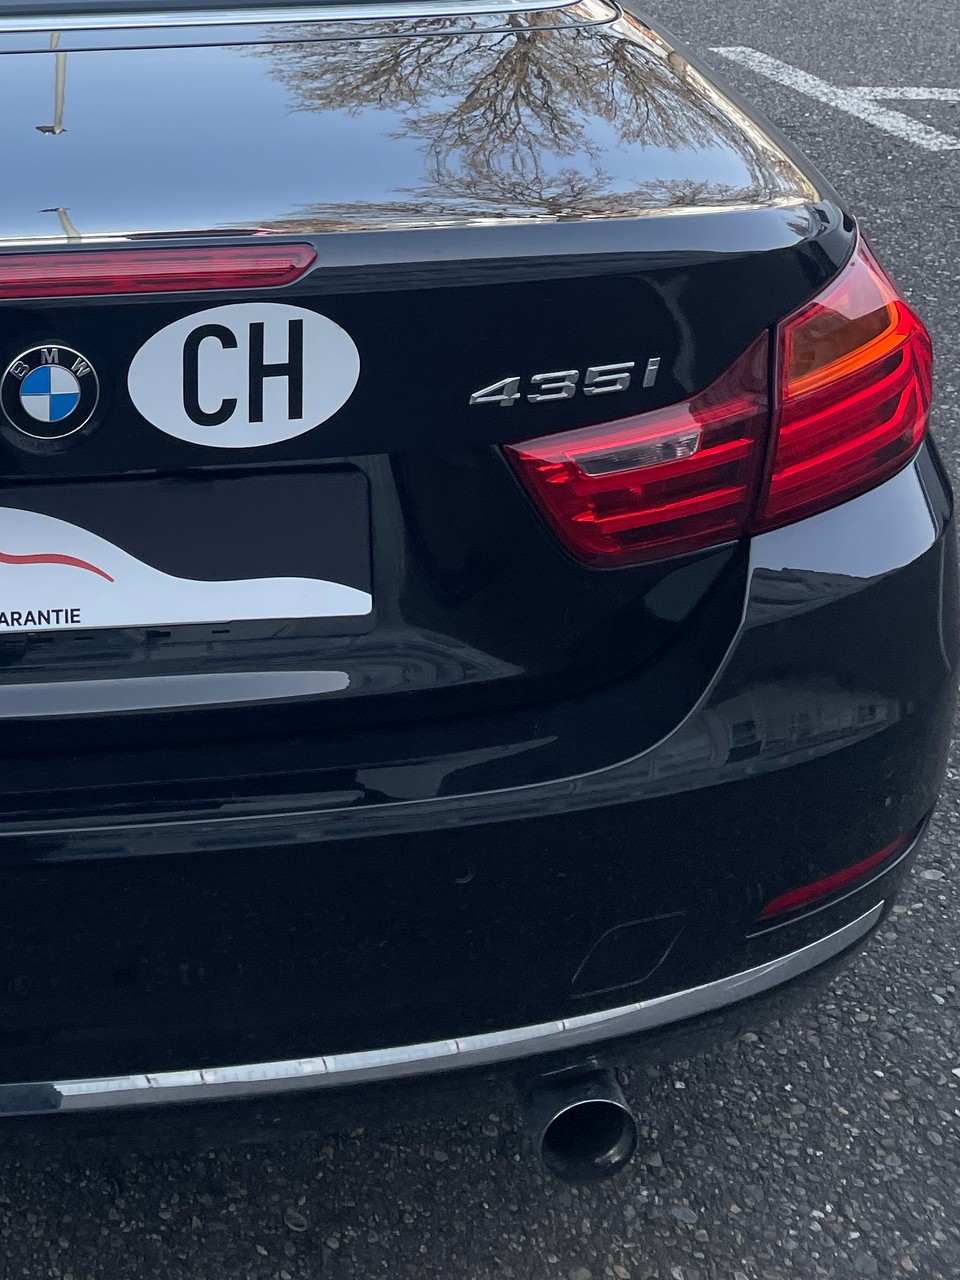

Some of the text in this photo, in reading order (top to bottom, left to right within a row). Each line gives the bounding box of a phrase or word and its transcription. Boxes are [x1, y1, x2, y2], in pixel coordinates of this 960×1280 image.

[9, 347, 91, 381] BMW
[183, 318, 304, 427] CH
[469, 357, 661, 407] 435i
